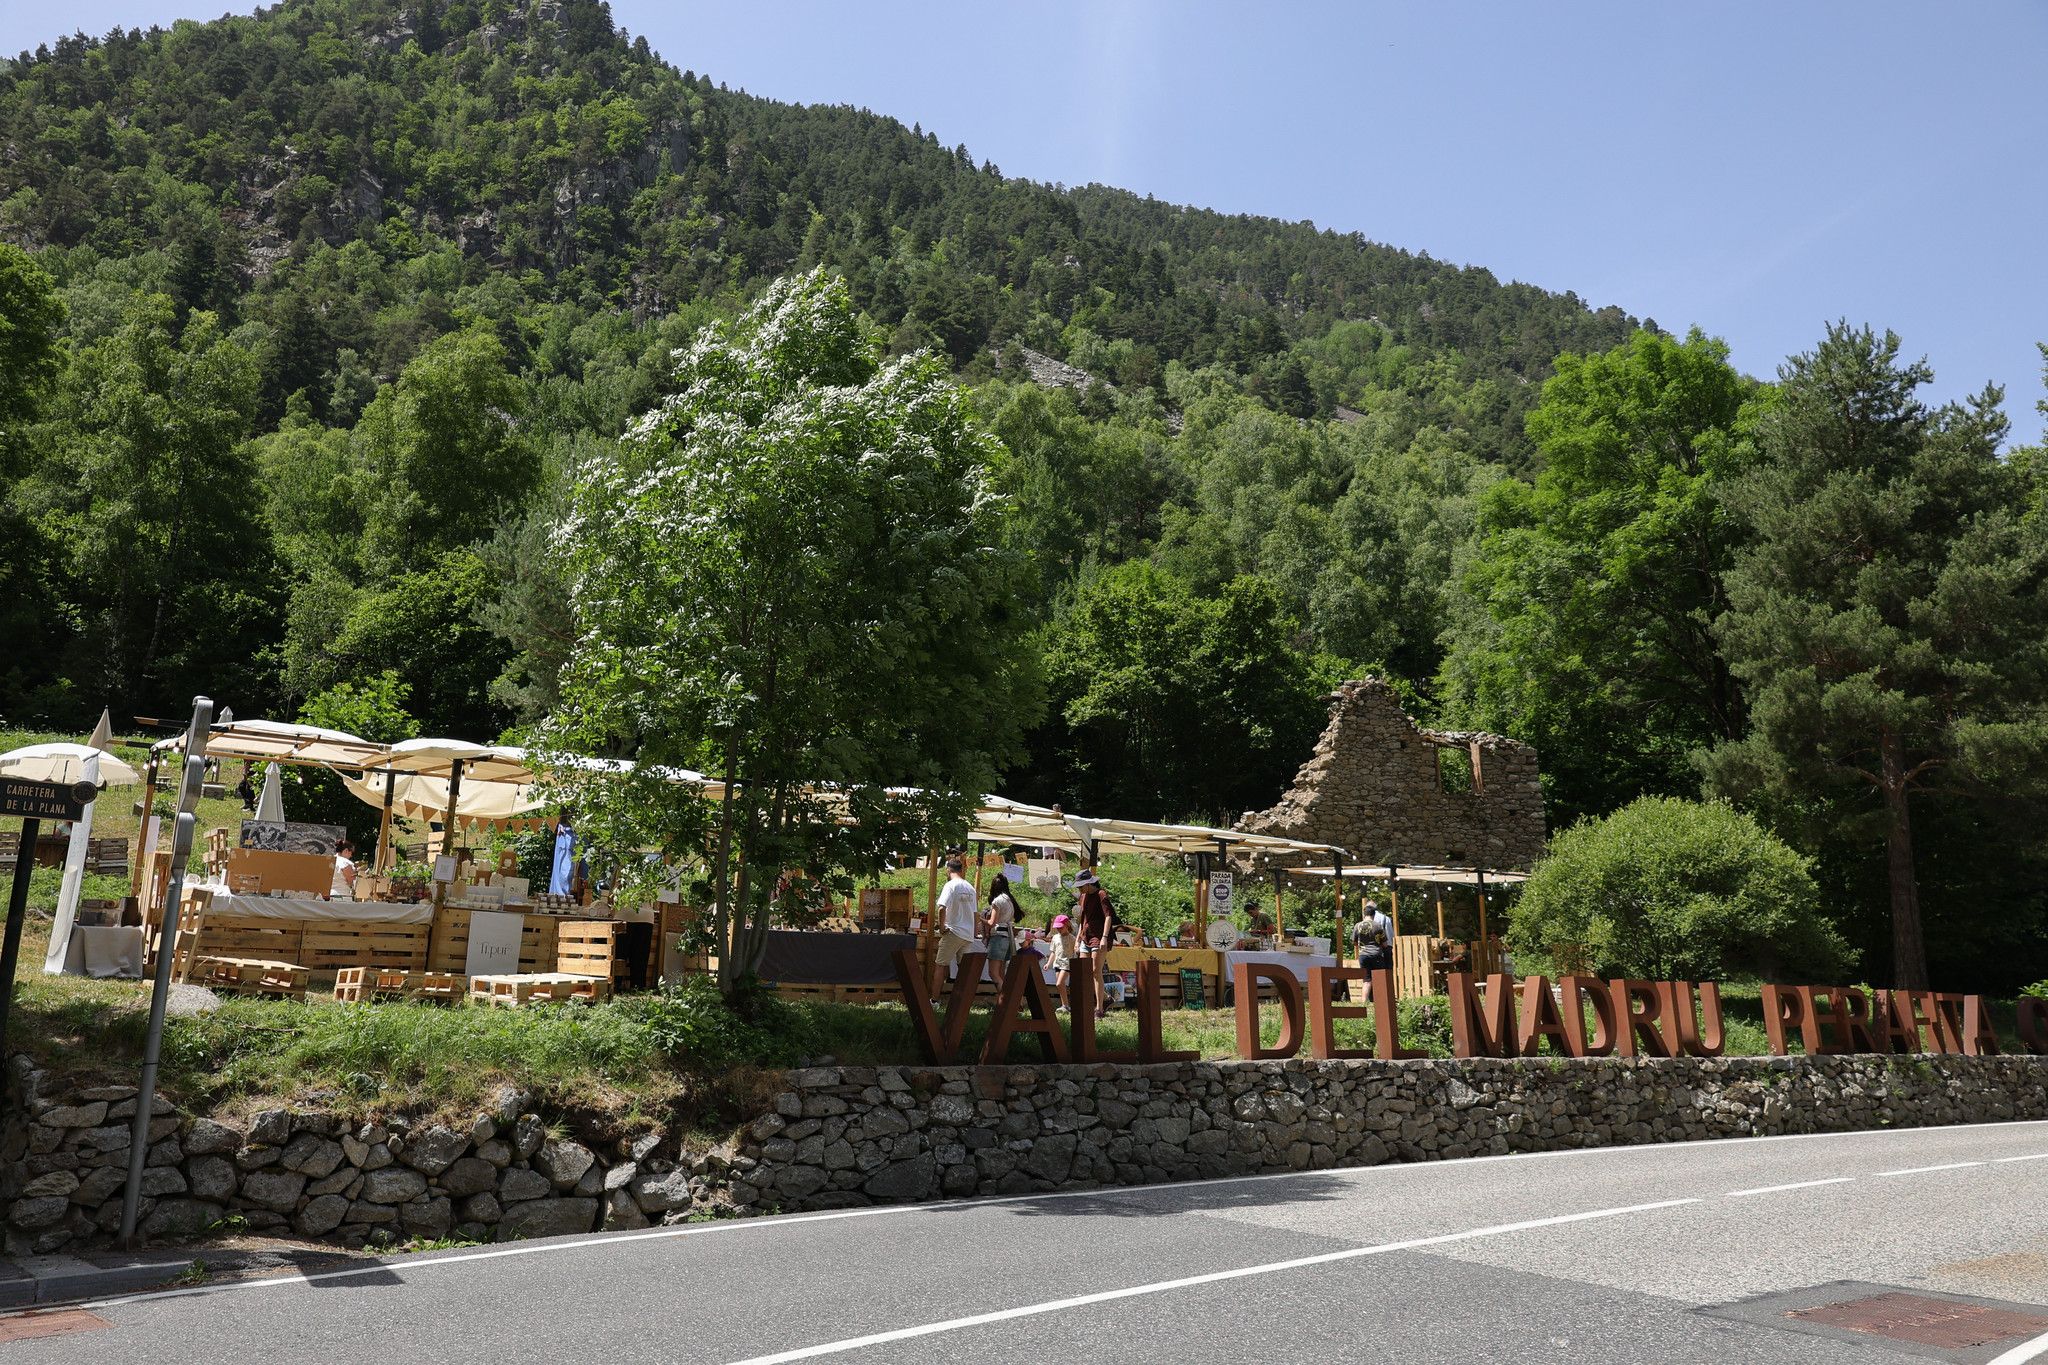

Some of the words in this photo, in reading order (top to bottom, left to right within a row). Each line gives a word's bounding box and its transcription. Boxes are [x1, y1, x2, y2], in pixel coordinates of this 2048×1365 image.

[6, 784, 55, 799] CARRETERA
[6, 799, 17, 810] DE
[23, 801, 34, 812] LA
[39, 803, 66, 814] PLANA
[891, 950, 1201, 1065] VALL
[1234, 963, 1429, 1061] DEL
[1447, 972, 1726, 1059] MADRIU
[1761, 983, 2001, 1056] PERAFITA
